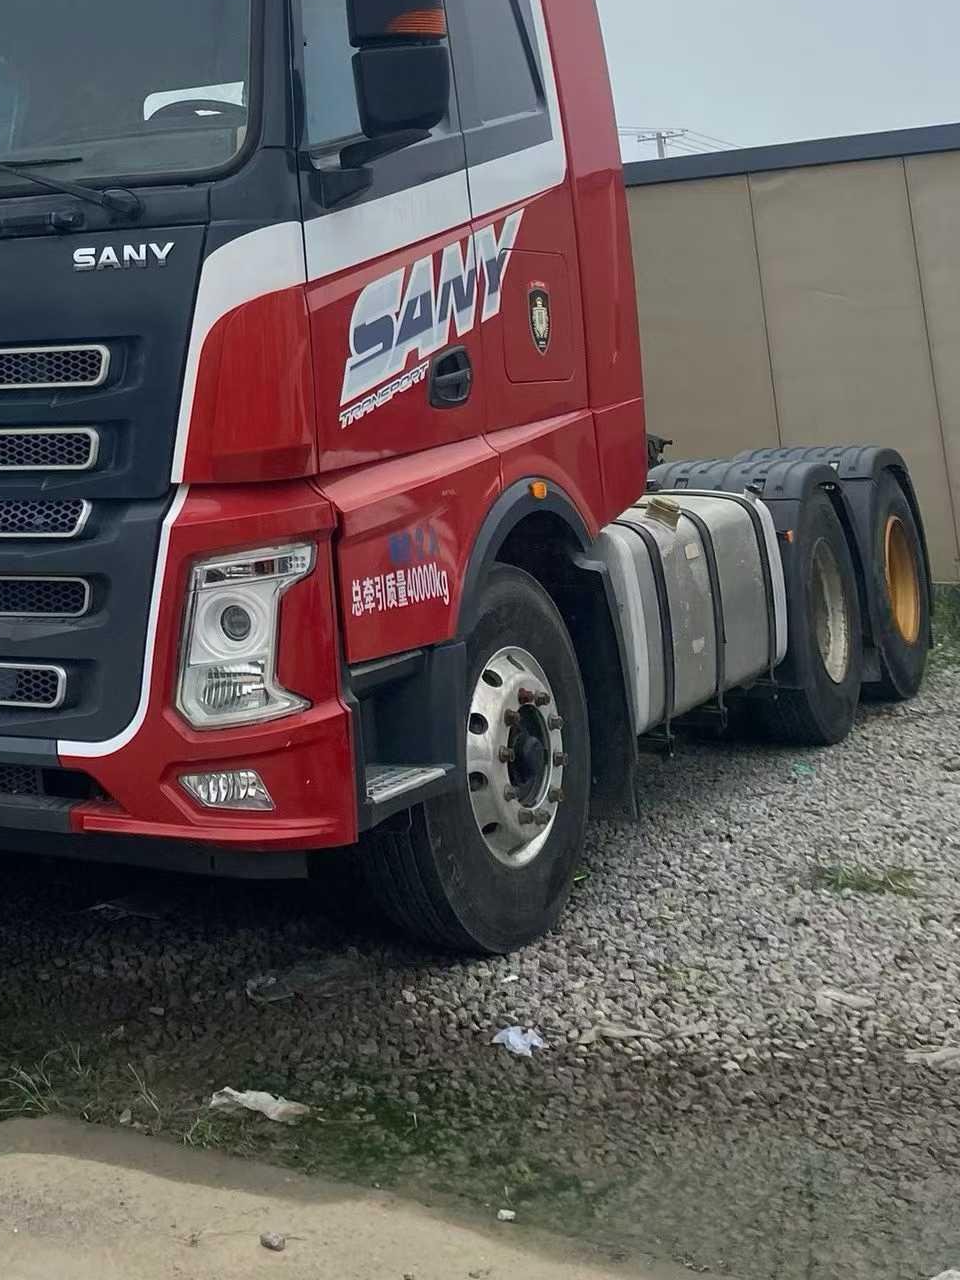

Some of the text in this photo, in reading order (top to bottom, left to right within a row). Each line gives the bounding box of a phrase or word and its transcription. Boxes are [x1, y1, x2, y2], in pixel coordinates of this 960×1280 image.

[73, 242, 175, 271] SANY
[340, 208, 525, 407] SANY
[339, 361, 429, 430] TRANSPORT
[351, 561, 450, 616] 总牵引质量40000kg
